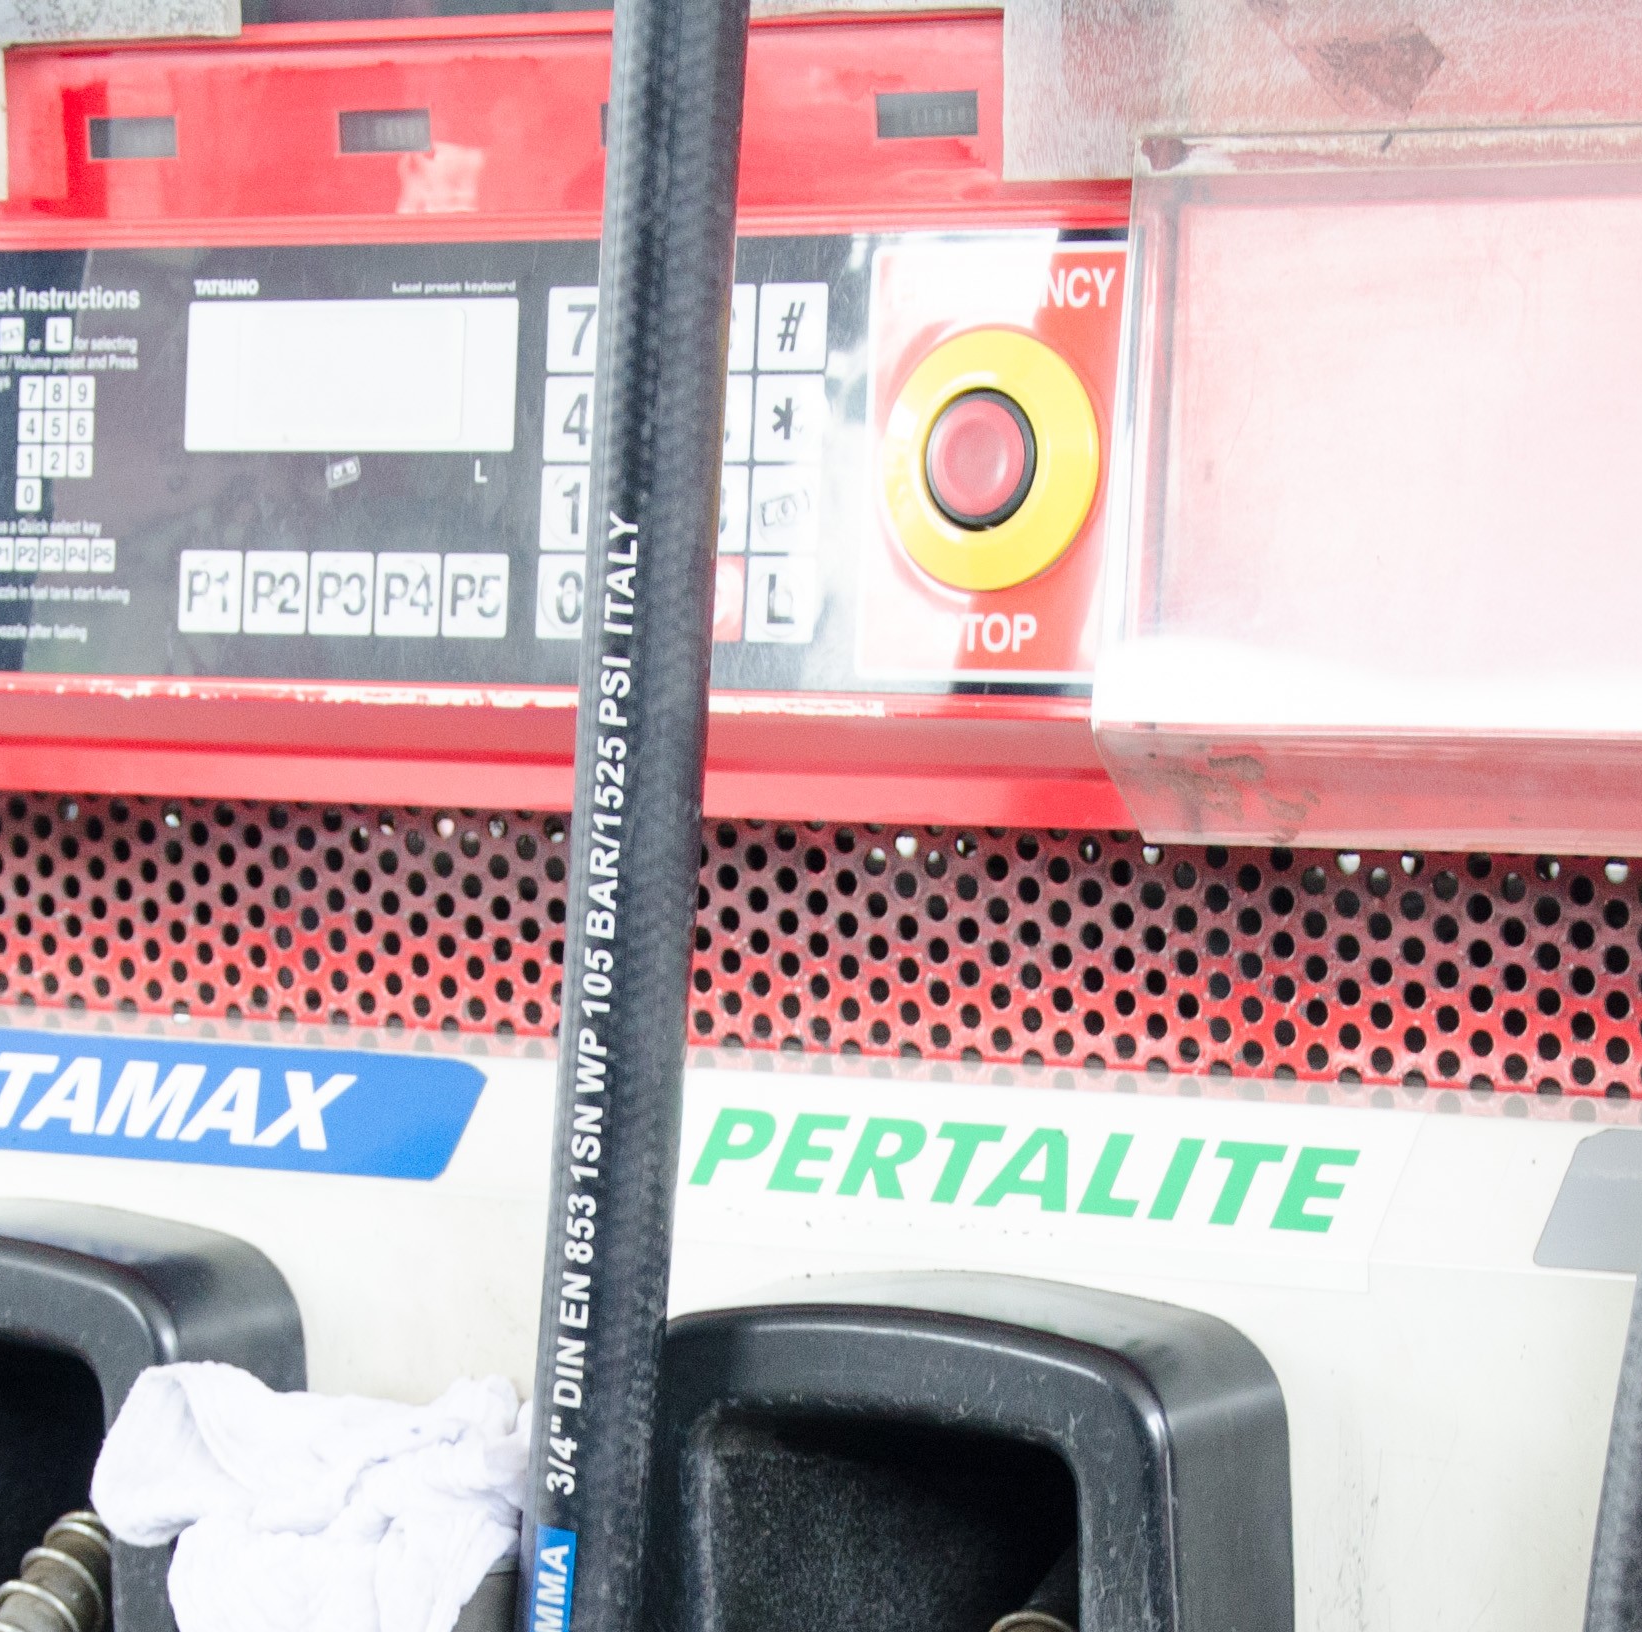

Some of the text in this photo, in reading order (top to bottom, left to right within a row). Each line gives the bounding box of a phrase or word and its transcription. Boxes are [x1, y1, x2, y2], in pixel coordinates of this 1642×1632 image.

[18, 284, 141, 311] Instructions
[194, 278, 260, 296] TATSUNO
[391, 279, 517, 296] Local preset keyboard
[27, 338, 42, 352] or
[53, 324, 64, 345] L
[90, 335, 138, 355] selecting
[567, 303, 597, 357] 7
[776, 301, 807, 353] #
[14, 355, 52, 371] Volume
[53, 356, 86, 373] preset
[87, 354, 107, 370] and
[108, 354, 139, 371] Press
[28, 383, 88, 402] 7 8 9
[26, 417, 86, 437] 4 5 6
[562, 392, 590, 446] 4
[50, 451, 60, 471] 2
[75, 451, 85, 471] 3
[474, 459, 488, 484] L
[23, 485, 34, 504] 0
[562, 481, 581, 536] 1
[17, 517, 49, 535] Quick
[82, 520, 103, 538] key
[18, 547, 36, 563] P2
[43, 547, 60, 563] P3
[68, 547, 86, 563] P4
[94, 547, 113, 564] P5
[187, 569, 795, 625] P1 P2 P3 P4 P5 0 L
[959, 612, 1038, 653] TOP
[546, 511, 641, 1496] 3/4" DIN EN 853 1SN WP 105 BAR/1525 PSI ITALY
[687, 1106, 1361, 1234] PERTALITE
